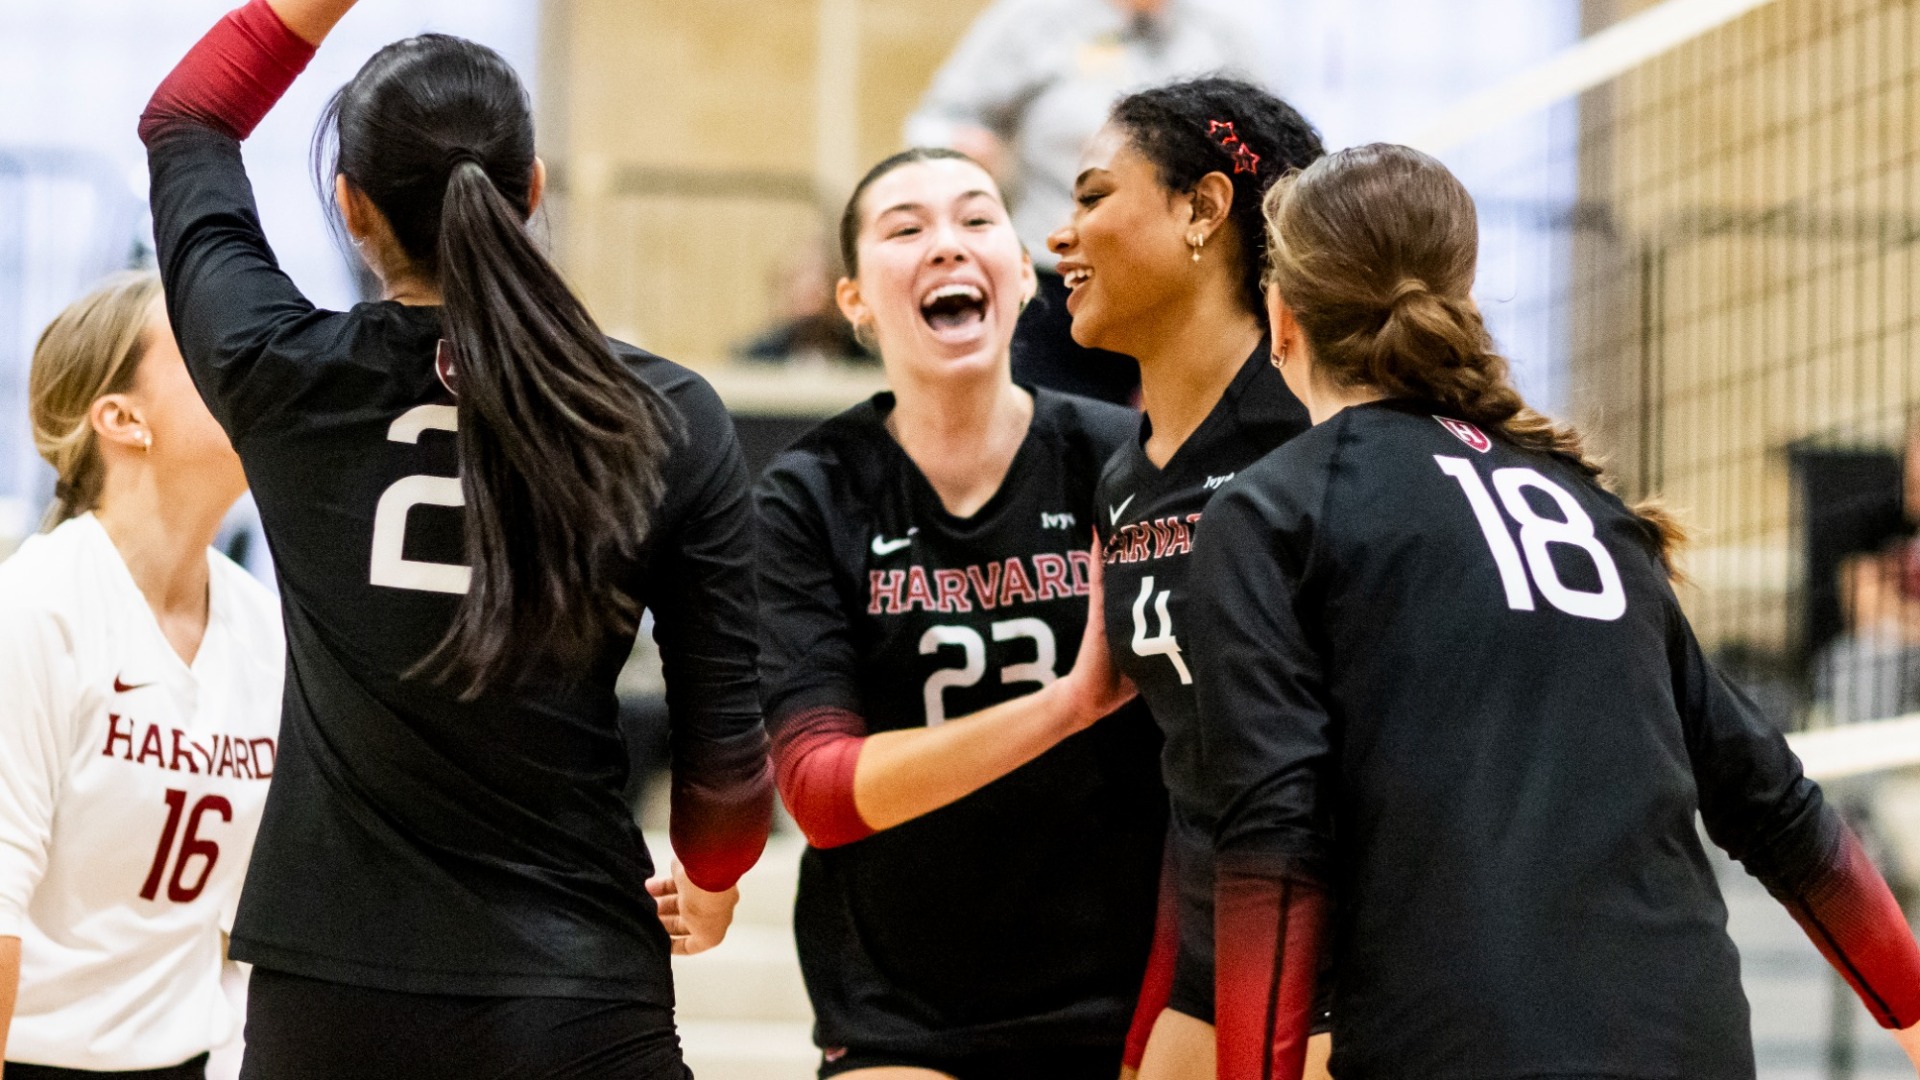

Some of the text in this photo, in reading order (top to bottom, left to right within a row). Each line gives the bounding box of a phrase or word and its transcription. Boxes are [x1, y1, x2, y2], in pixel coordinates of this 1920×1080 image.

[1446, 420, 1483, 444] H
[370, 403, 473, 595] 2
[1103, 512, 1202, 564] ARVA
[1433, 454, 1627, 621] 18
[867, 551, 1090, 614] HARVARD
[1132, 576, 1193, 684] 4
[918, 617, 1058, 729] 23
[102, 713, 277, 780] HARVARD
[139, 788, 233, 904] 16
